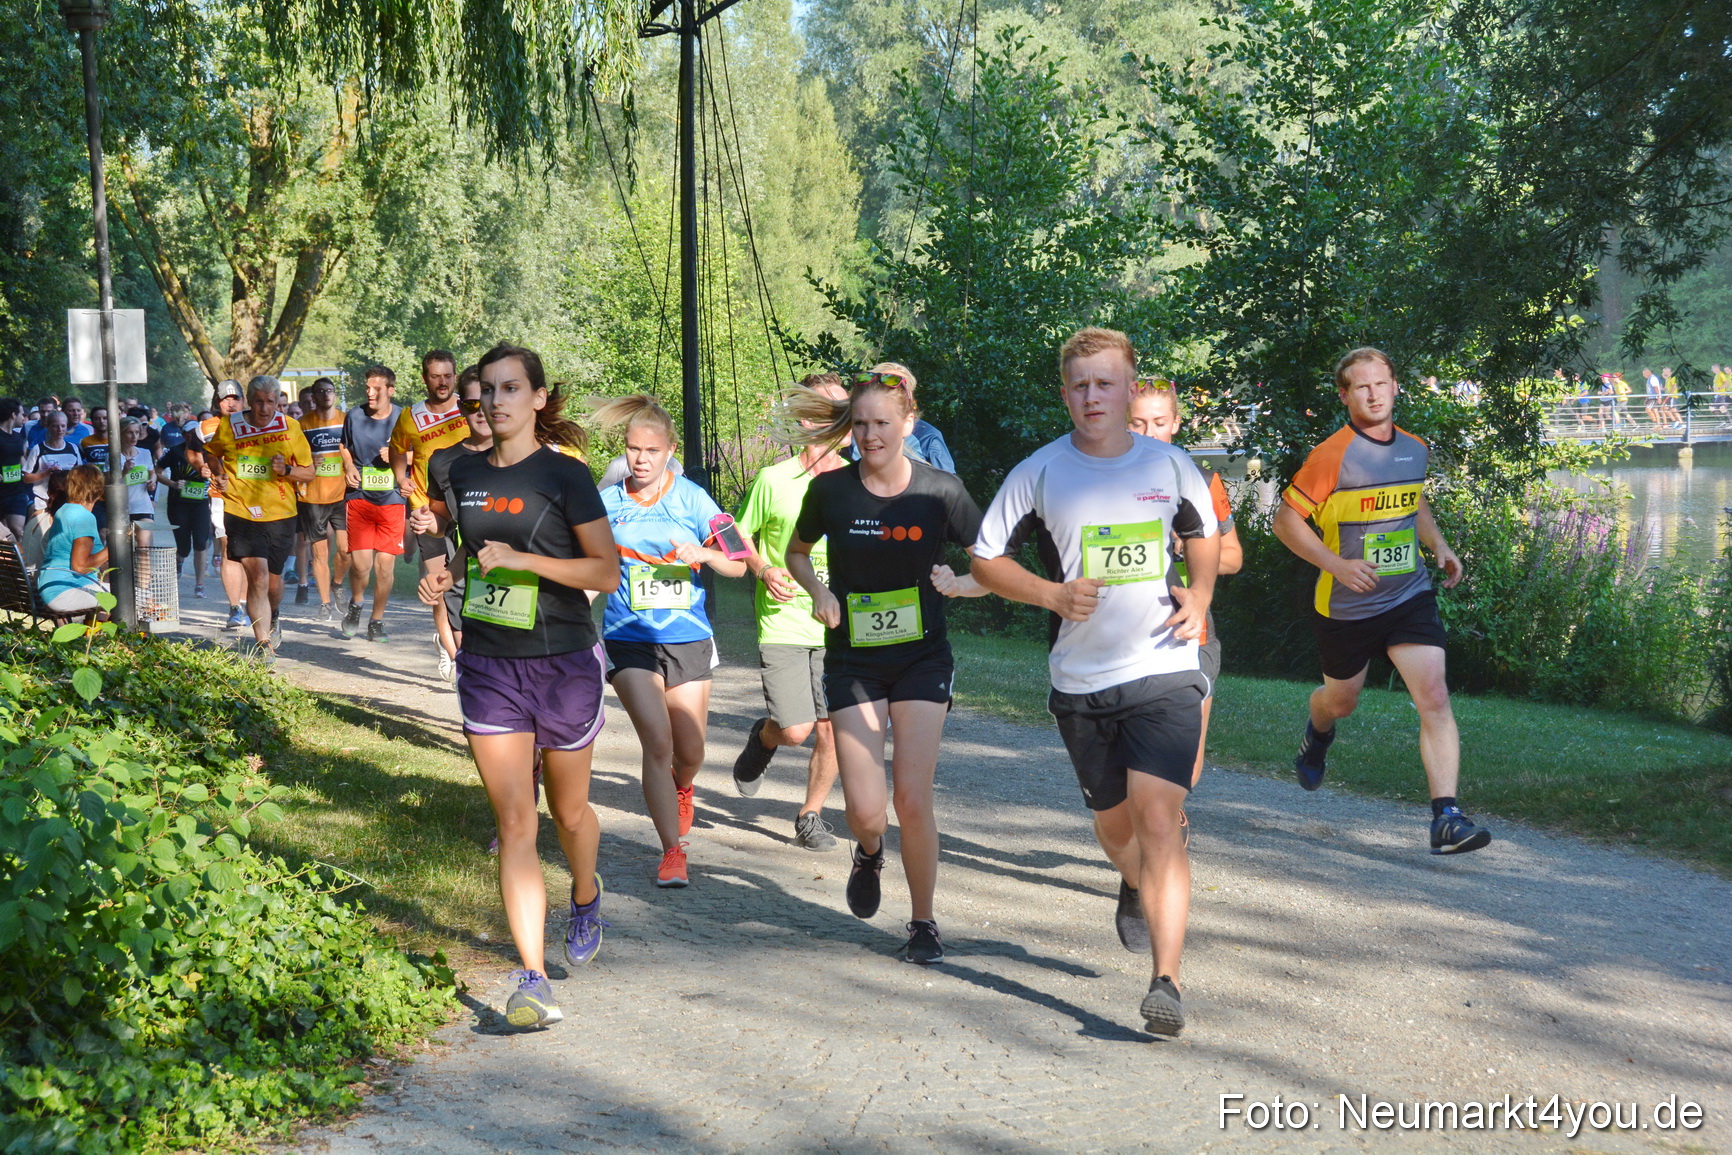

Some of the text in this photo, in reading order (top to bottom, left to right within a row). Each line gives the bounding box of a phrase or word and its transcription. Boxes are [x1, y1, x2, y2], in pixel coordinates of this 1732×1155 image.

[420, 427, 446, 443] MAX
[236, 434, 291, 449] MAX BÖGL
[318, 437, 341, 445] Fische
[241, 463, 267, 474] 1269
[130, 472, 143, 480] 697
[367, 475, 390, 484] 1080
[185, 486, 202, 495] 1429
[1101, 544, 1147, 568] 763
[1372, 545, 1411, 563] 1387
[484, 584, 511, 607] 37
[510, 610, 531, 618] Sandra
[870, 610, 898, 631] 32
[865, 630, 894, 638] Klingshirn
